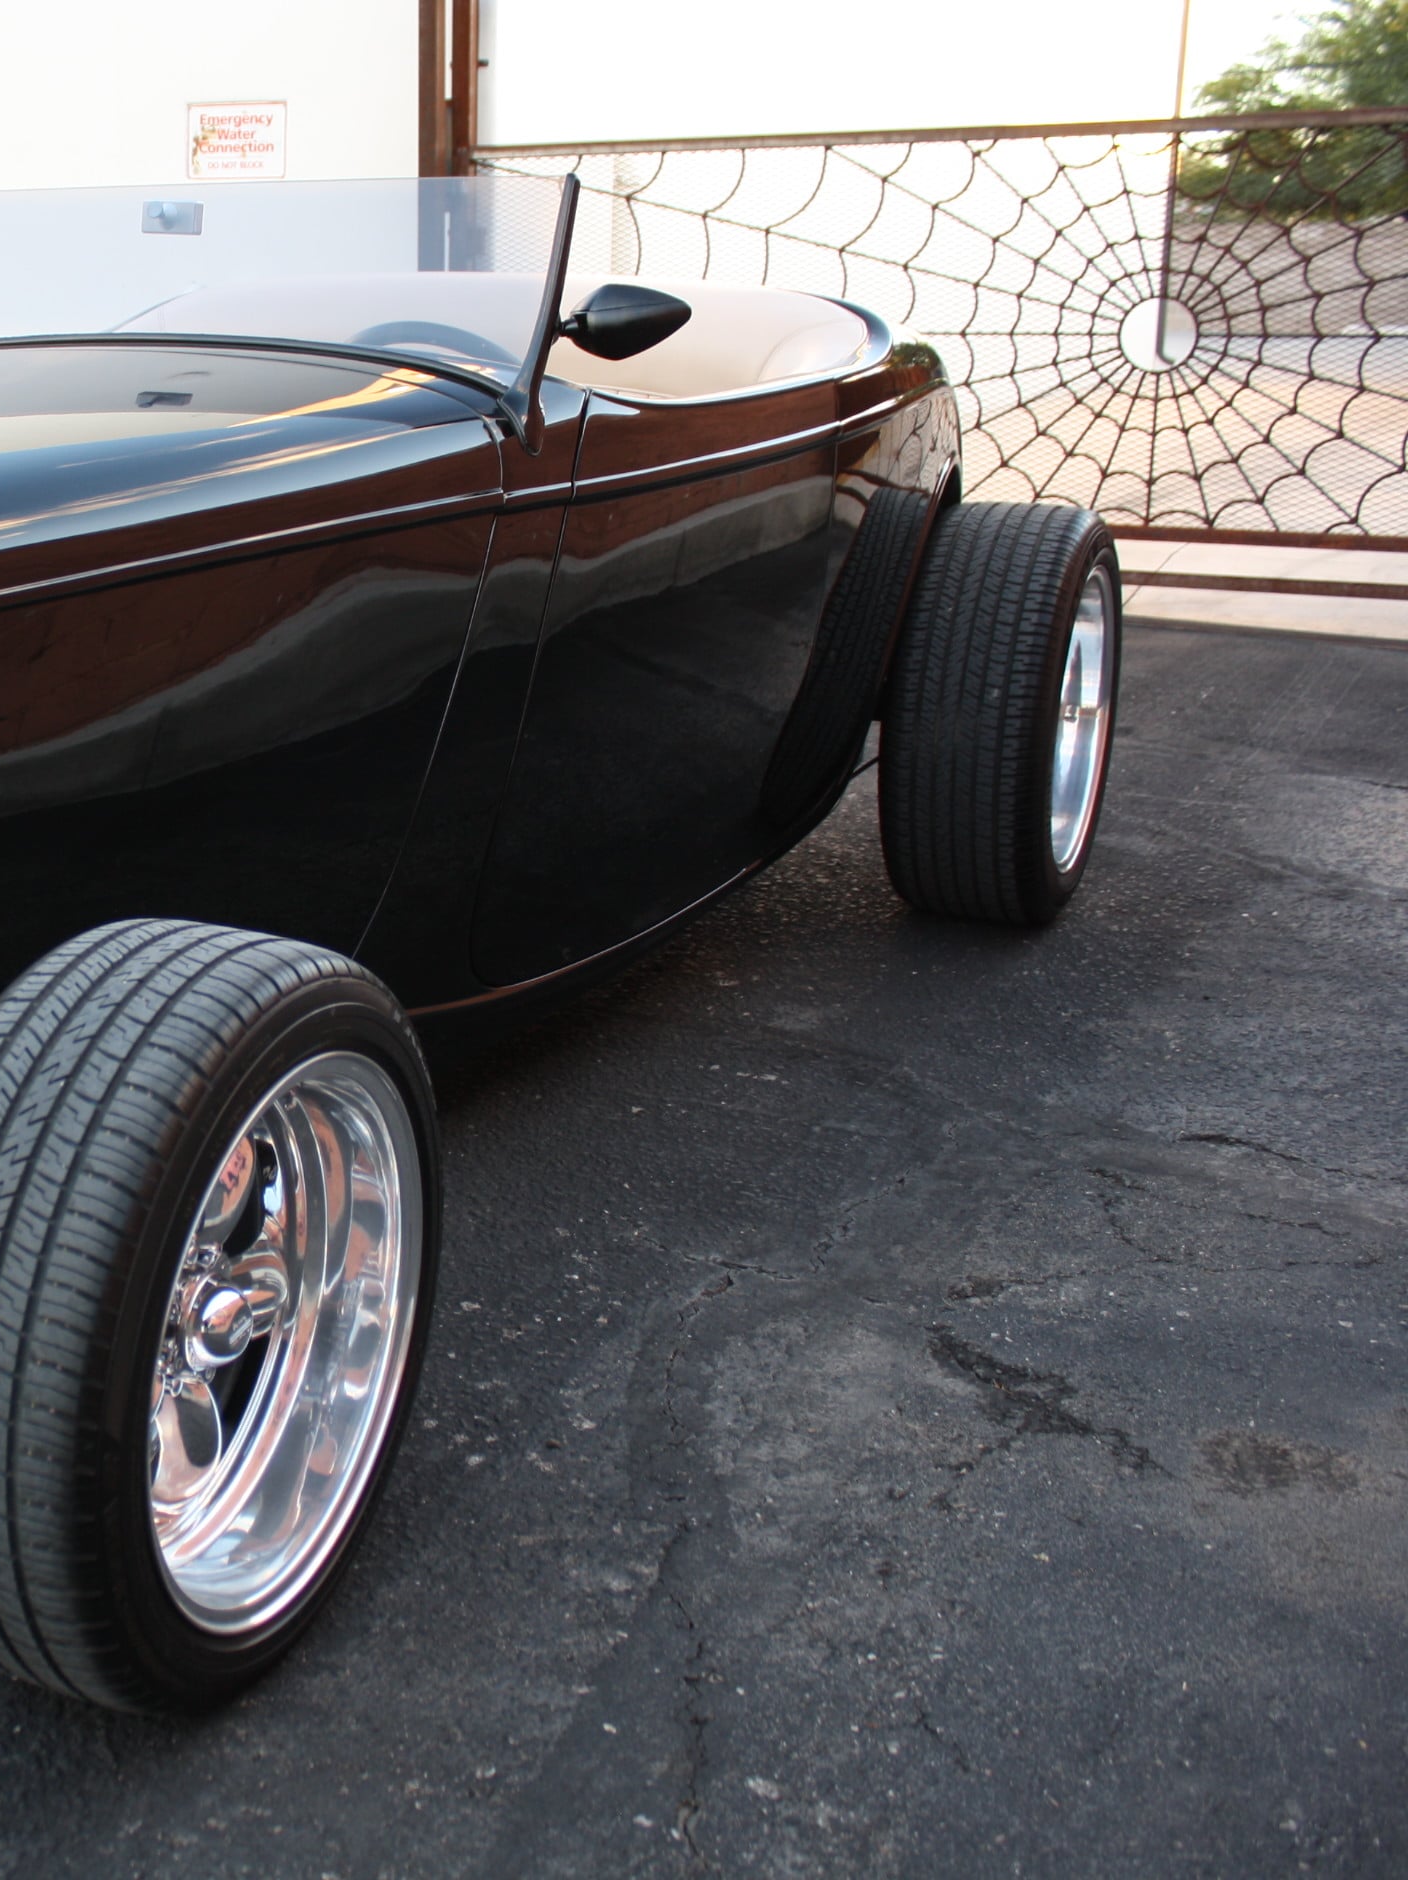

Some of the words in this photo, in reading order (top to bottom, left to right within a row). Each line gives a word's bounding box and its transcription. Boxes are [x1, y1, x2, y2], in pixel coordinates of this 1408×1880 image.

[200, 113, 273, 127] Emergency
[217, 128, 256, 140] Water
[199, 141, 274, 153] Connection
[208, 161, 219, 169] DO
[222, 161, 237, 169] NOT
[240, 161, 264, 169] BLOCK
